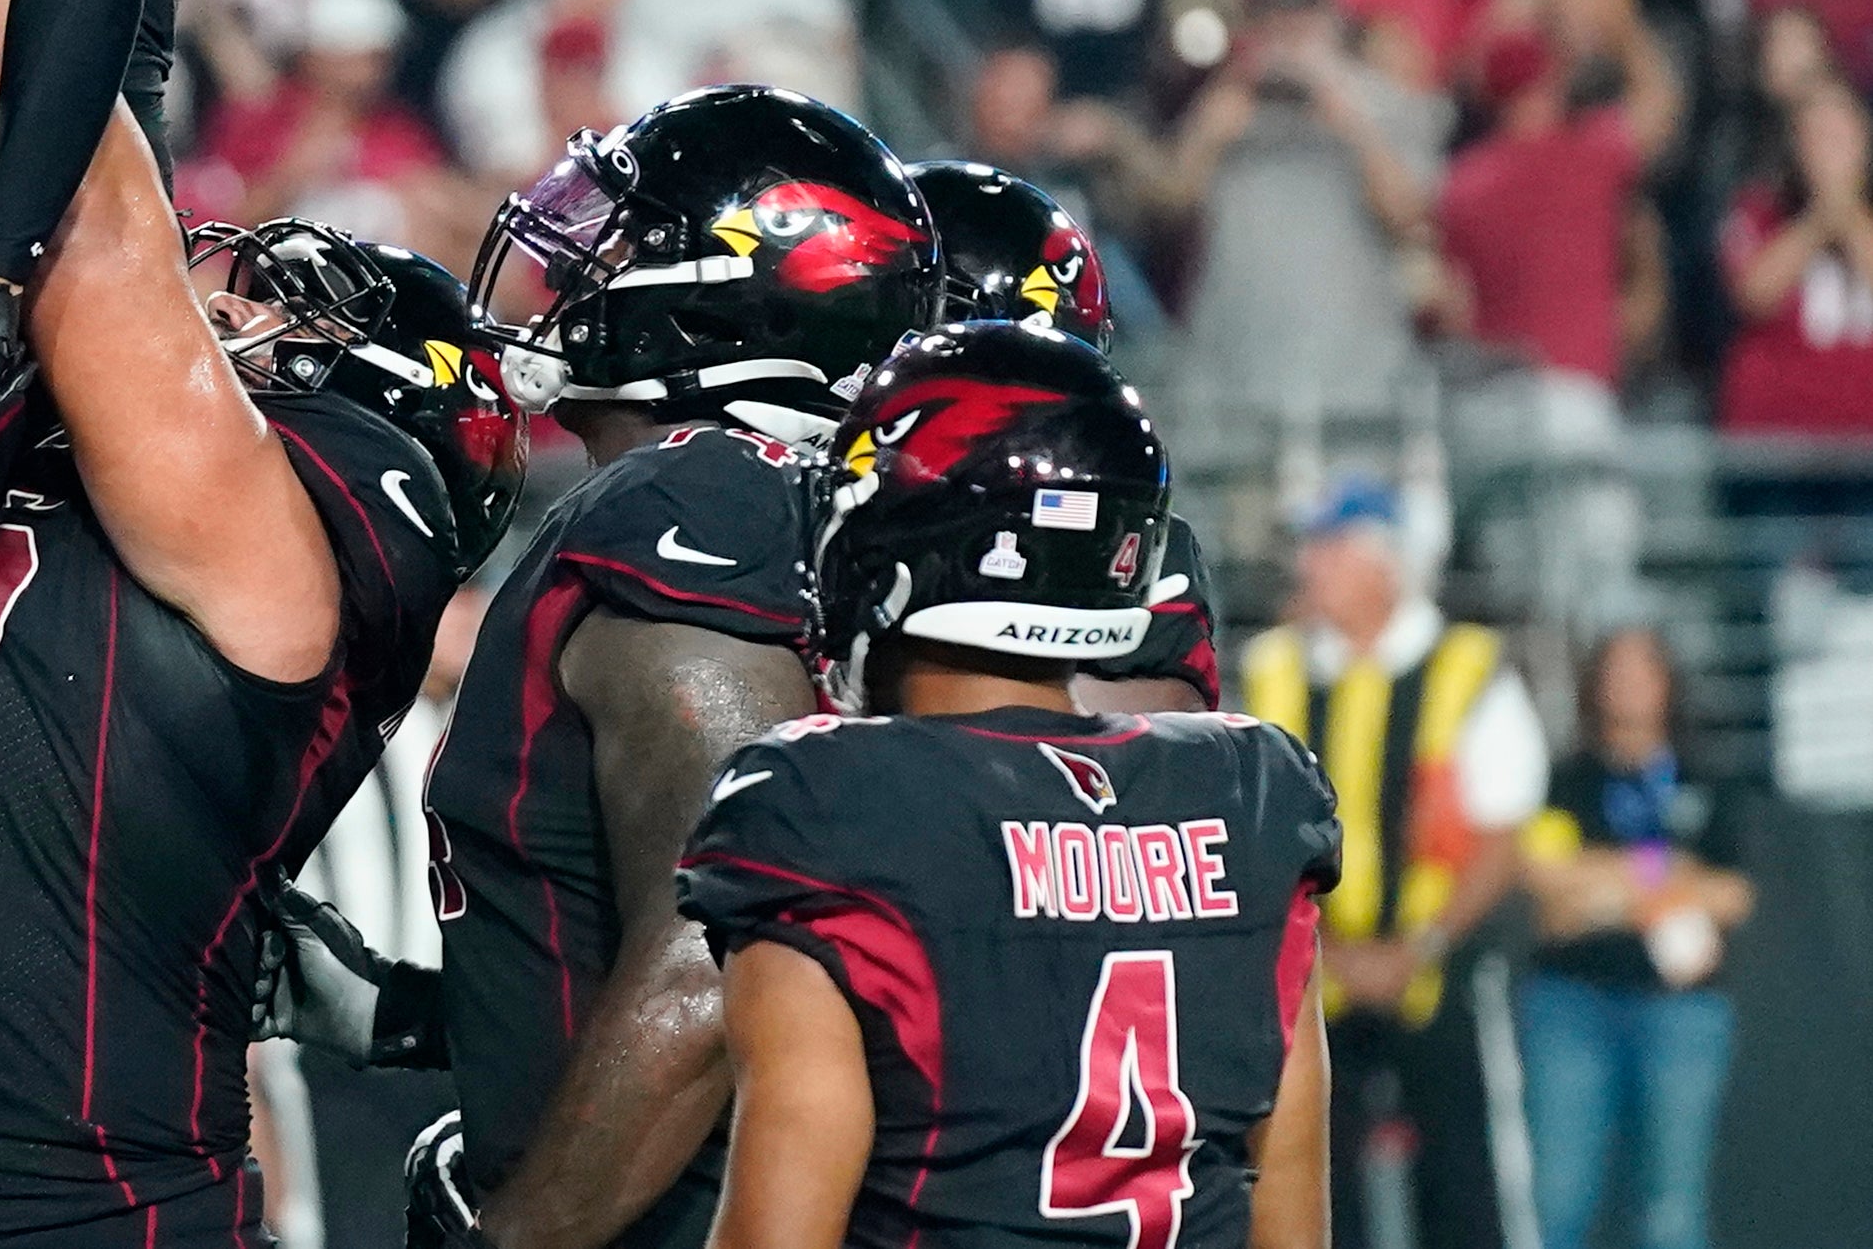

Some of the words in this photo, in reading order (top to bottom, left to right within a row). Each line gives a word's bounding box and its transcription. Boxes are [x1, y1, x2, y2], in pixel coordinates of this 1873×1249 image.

[1108, 532, 1142, 588] 4
[996, 621, 1134, 646] ARIZONA
[1000, 817, 1240, 923] MOORE
[1038, 950, 1200, 1249] 4
